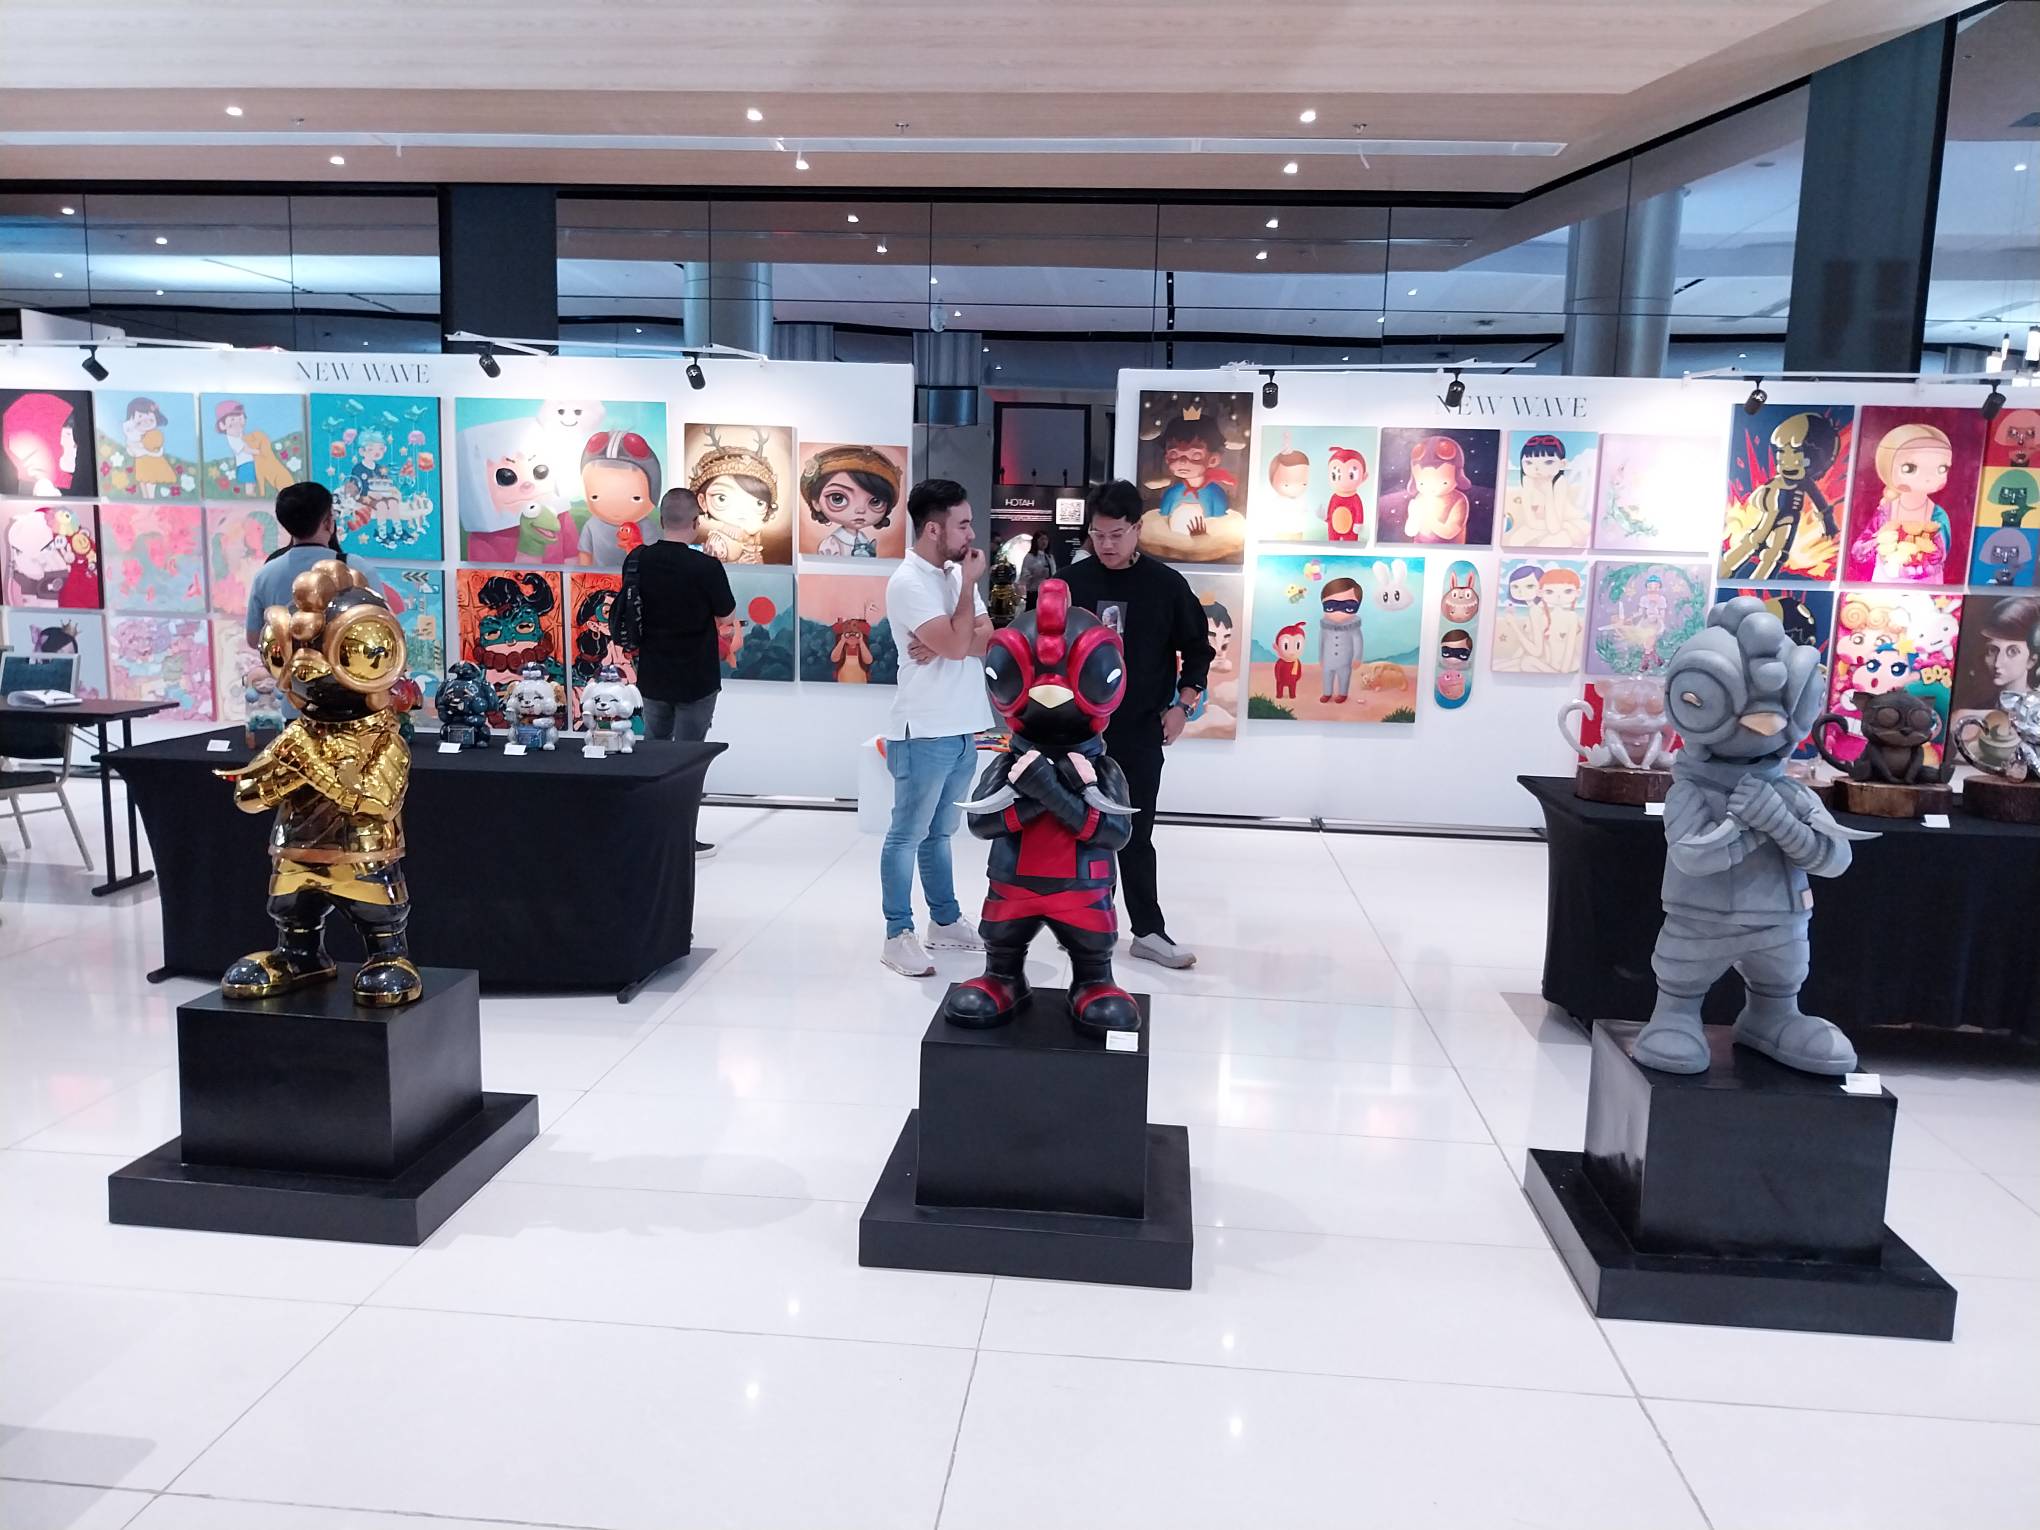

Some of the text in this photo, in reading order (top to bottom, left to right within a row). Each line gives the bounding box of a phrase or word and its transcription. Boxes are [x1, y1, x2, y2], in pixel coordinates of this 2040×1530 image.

[296, 361, 431, 384] NEW WAVE
[1435, 394, 1588, 418] NEW WAVE
